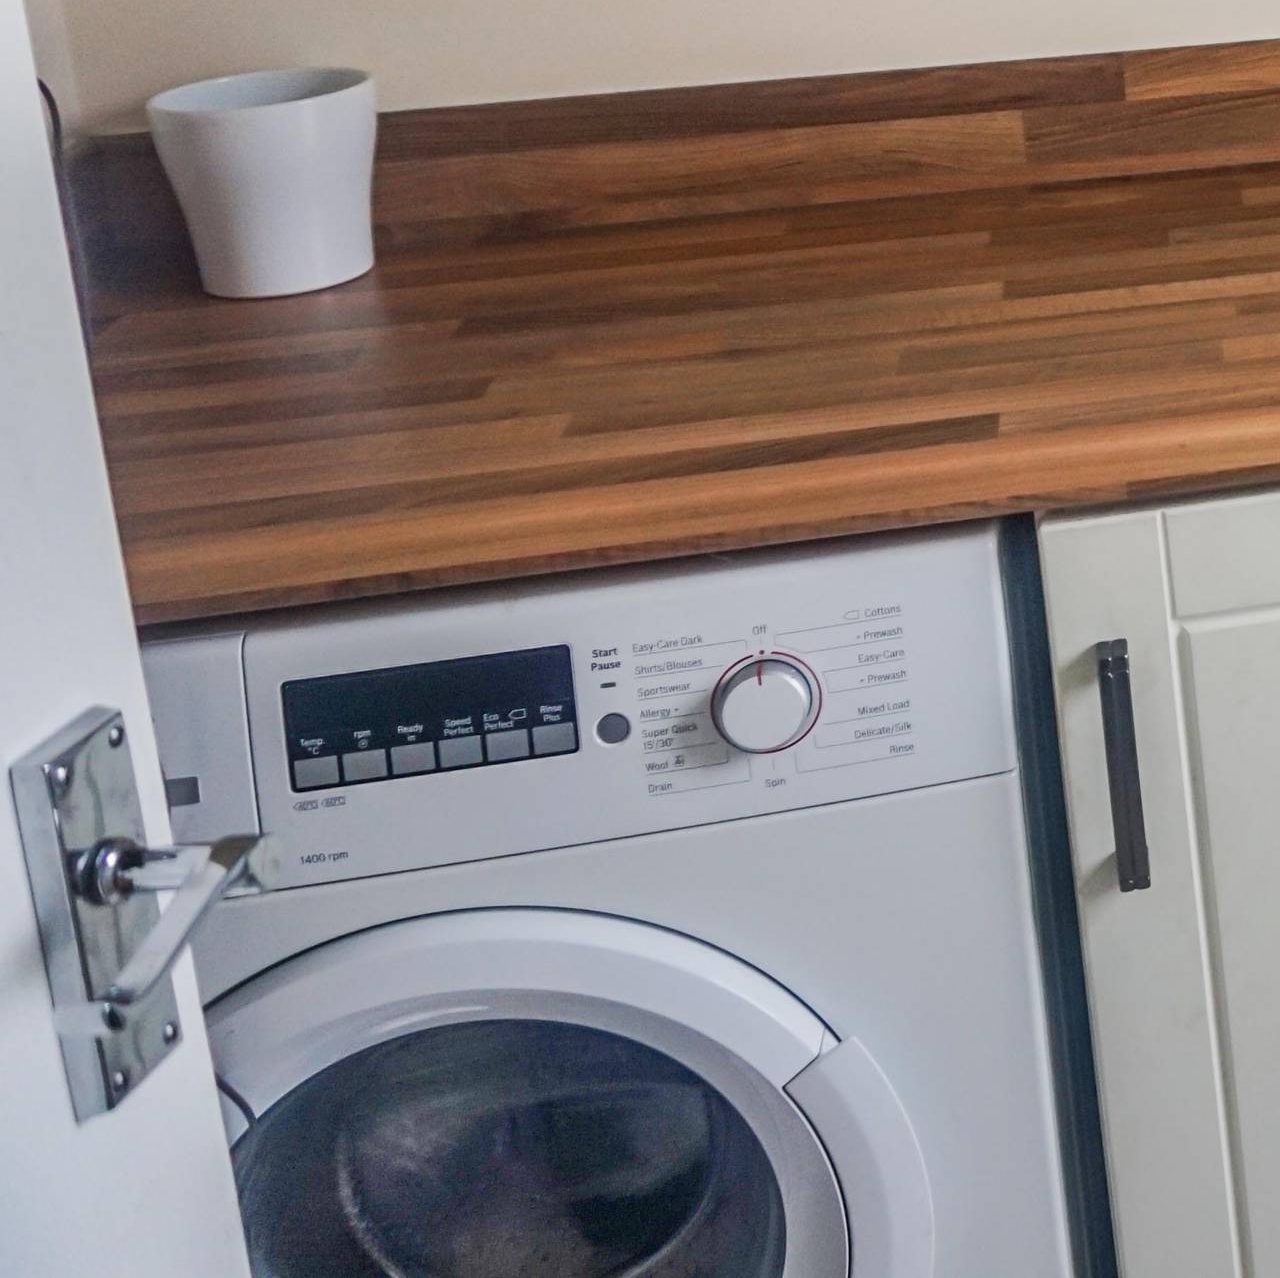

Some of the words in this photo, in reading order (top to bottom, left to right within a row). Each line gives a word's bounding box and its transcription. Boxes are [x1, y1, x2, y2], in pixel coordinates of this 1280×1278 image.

[864, 605, 902, 618] Cottons
[752, 625, 768, 634] Off
[863, 627, 903, 640] Prewash
[680, 634, 703, 646] Dark
[592, 647, 618, 659] Start
[590, 661, 622, 672] Pause
[867, 670, 907, 684] Prewash
[637, 683, 691, 698] Sportswear
[540, 705, 563, 715] Rinse
[639, 707, 672, 720] Allergy
[857, 704, 885, 716] Mixed
[887, 700, 911, 712] Load
[483, 713, 500, 723] Eco
[397, 723, 424, 736] Ready
[443, 725, 474, 738] Perfect
[484, 720, 515, 732] Perfect
[353, 730, 372, 740] rpm
[641, 728, 669, 742] Super
[889, 743, 915, 755] Rinse
[645, 762, 669, 773] Wool
[648, 783, 673, 795] Drain
[764, 778, 787, 790] Spin
[300, 854, 326, 865] 1400
[328, 851, 350, 863] rpm
